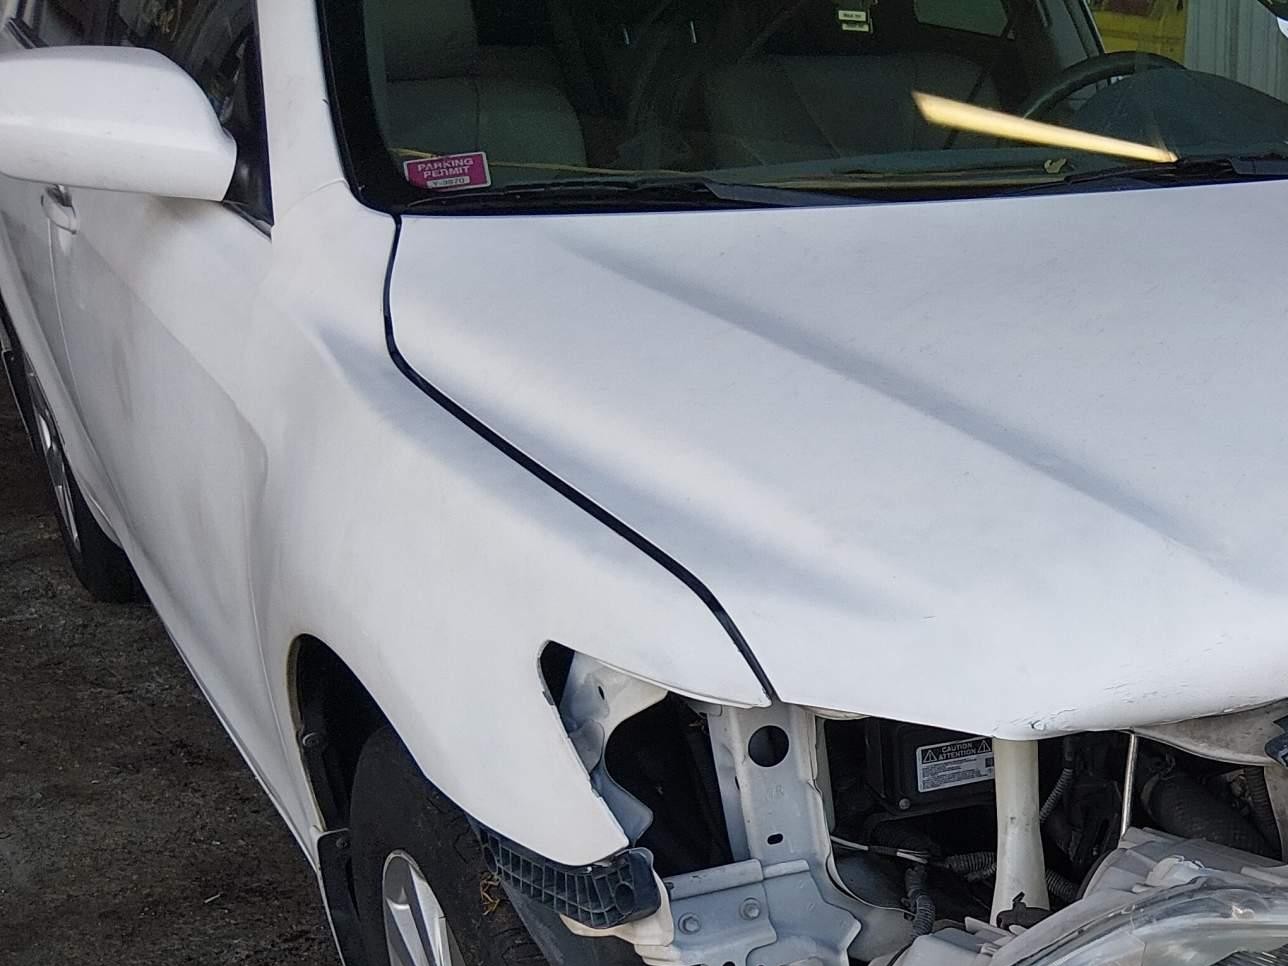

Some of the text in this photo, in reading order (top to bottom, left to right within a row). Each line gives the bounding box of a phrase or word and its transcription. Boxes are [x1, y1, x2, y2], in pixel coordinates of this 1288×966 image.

[417, 158, 474, 172] PARKING
[423, 165, 471, 179] PERMIT
[941, 742, 973, 753] CAUTION
[938, 748, 977, 761] ATTENTION
